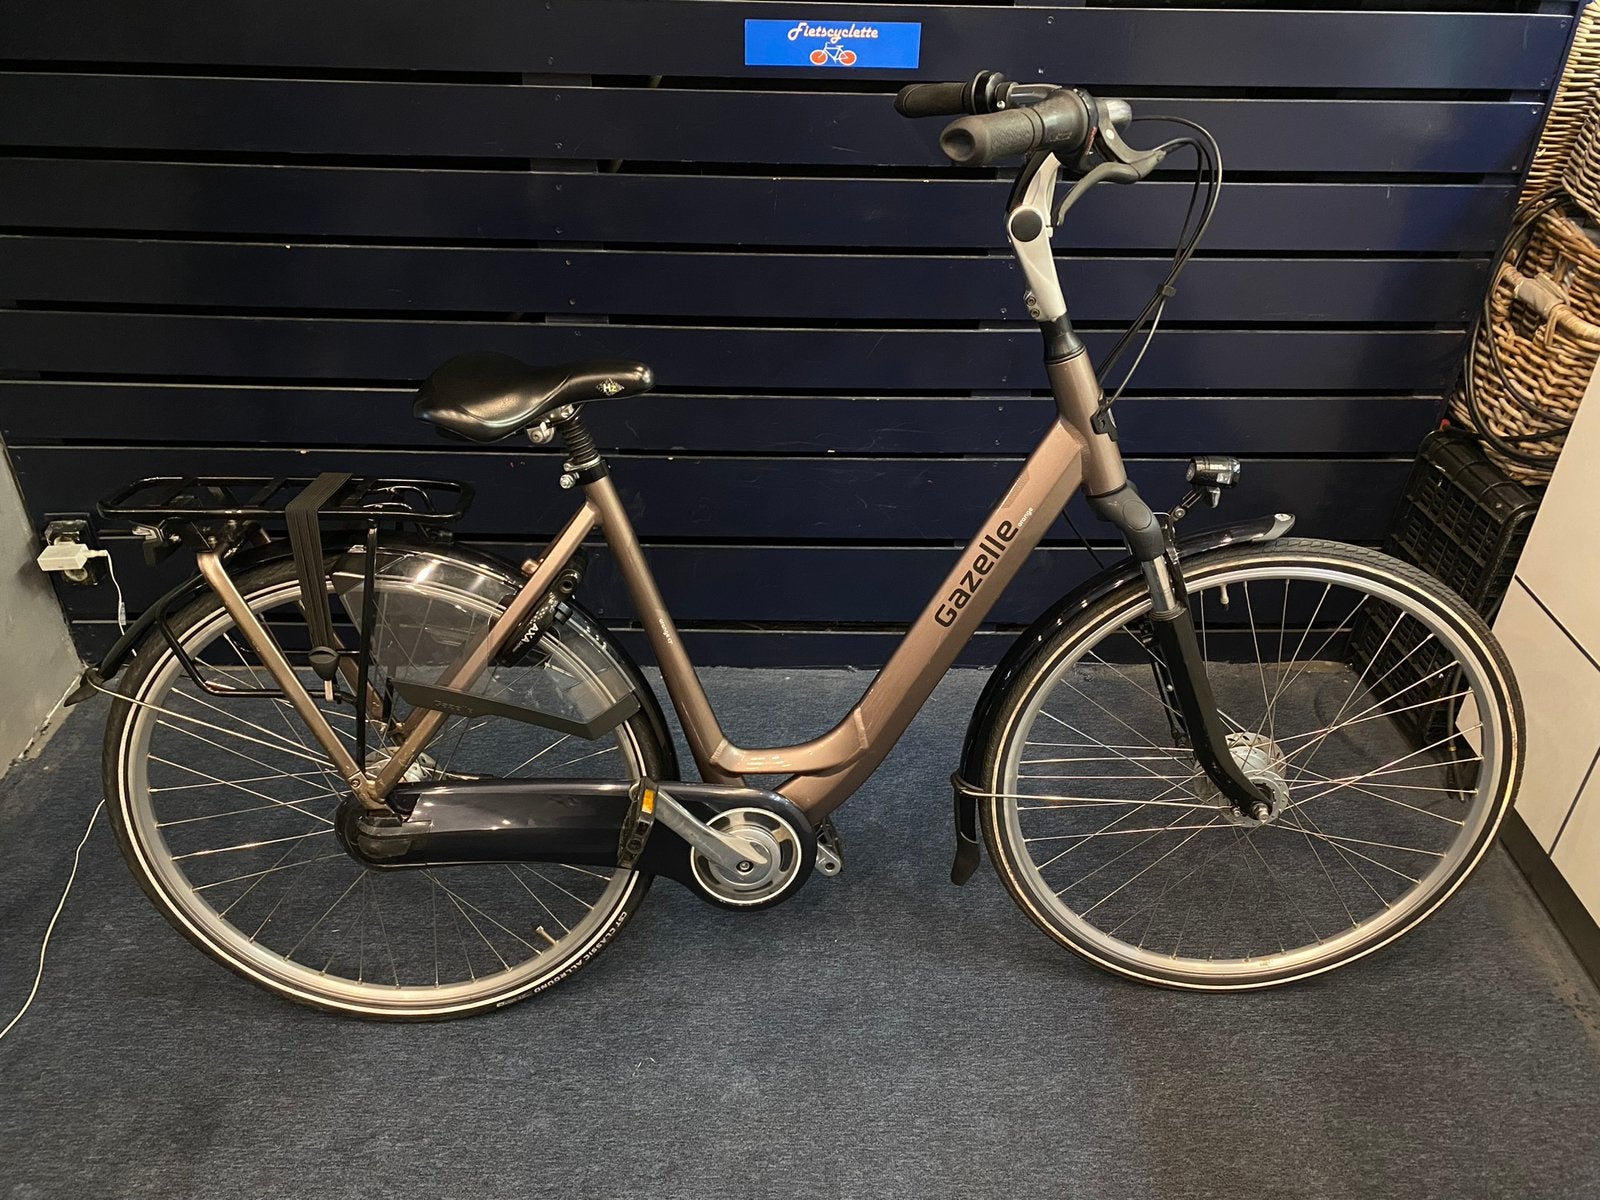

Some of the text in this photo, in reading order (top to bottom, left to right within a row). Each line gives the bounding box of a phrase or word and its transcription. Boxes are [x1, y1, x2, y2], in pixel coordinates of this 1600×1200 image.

[1017, 507, 1033, 527] orange
[934, 520, 1019, 627] Gazelle
[521, 623, 539, 643] AXA
[533, 911, 628, 994] CST CLASSIC ALLROUND
